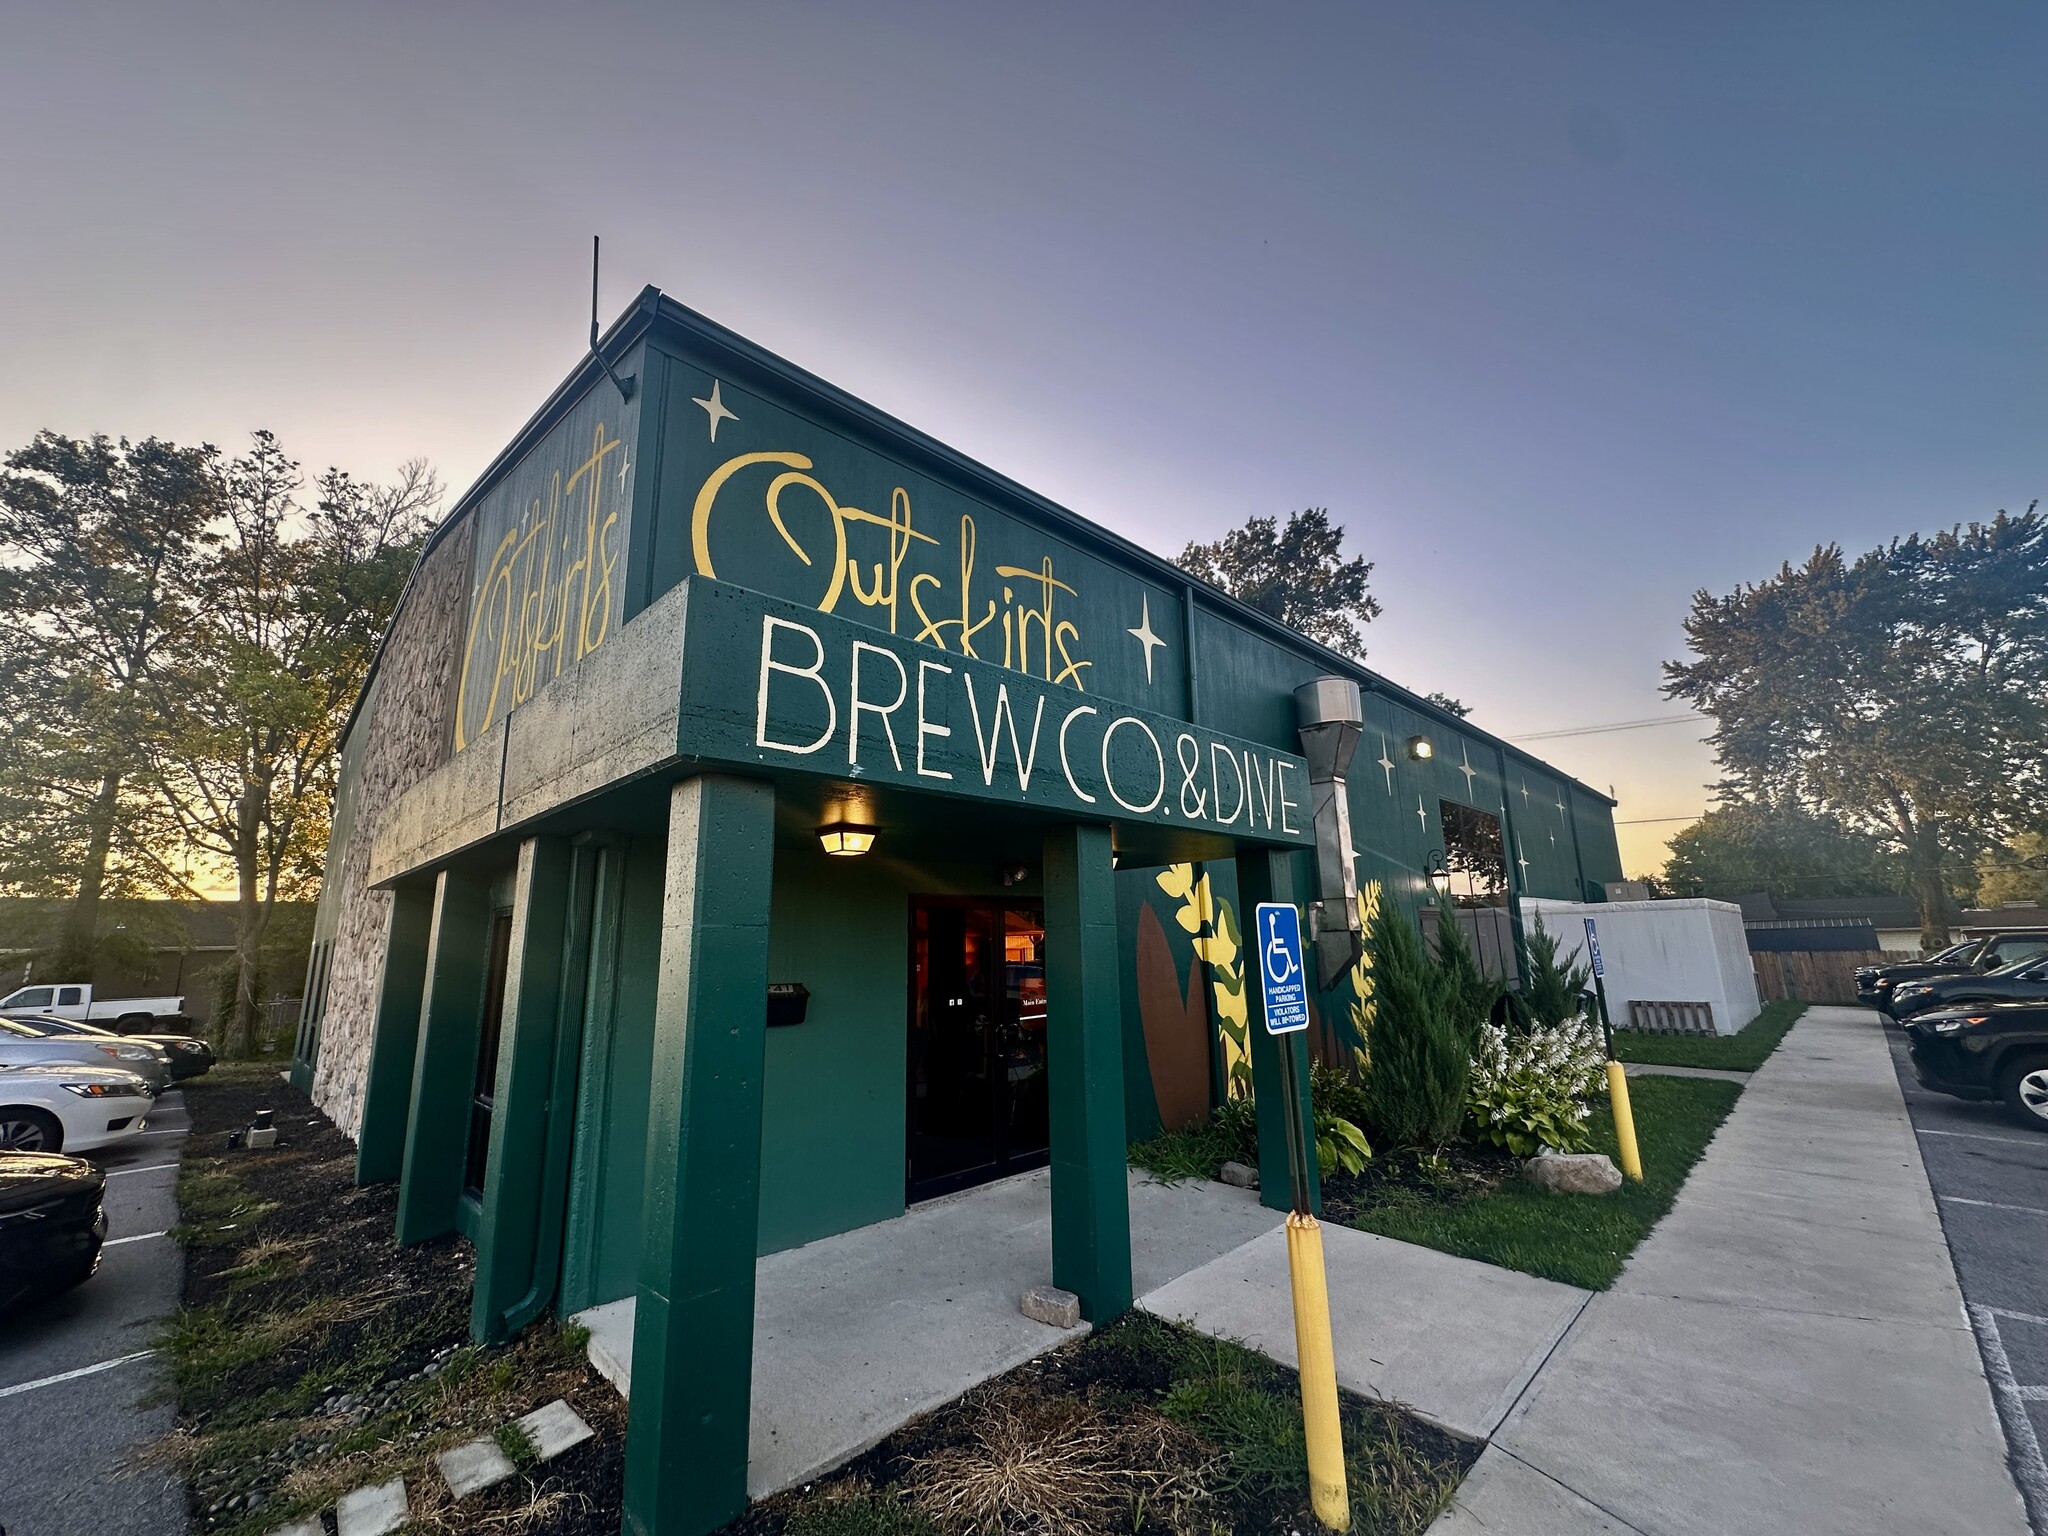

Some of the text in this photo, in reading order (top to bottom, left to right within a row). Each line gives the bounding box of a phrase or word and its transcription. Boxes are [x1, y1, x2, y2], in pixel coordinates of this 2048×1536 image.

[691, 452, 1092, 691] Outskirts
[456, 423, 621, 752] Outskirts
[755, 614, 1046, 792] BREW
[1210, 742, 1300, 835] DIVE
[1268, 984, 1301, 995] HANDICAPPED
[1275, 993, 1297, 1003] PARKING
[1273, 1005, 1301, 1016] VIOLATORS
[1270, 1017, 1281, 1026] WILL
